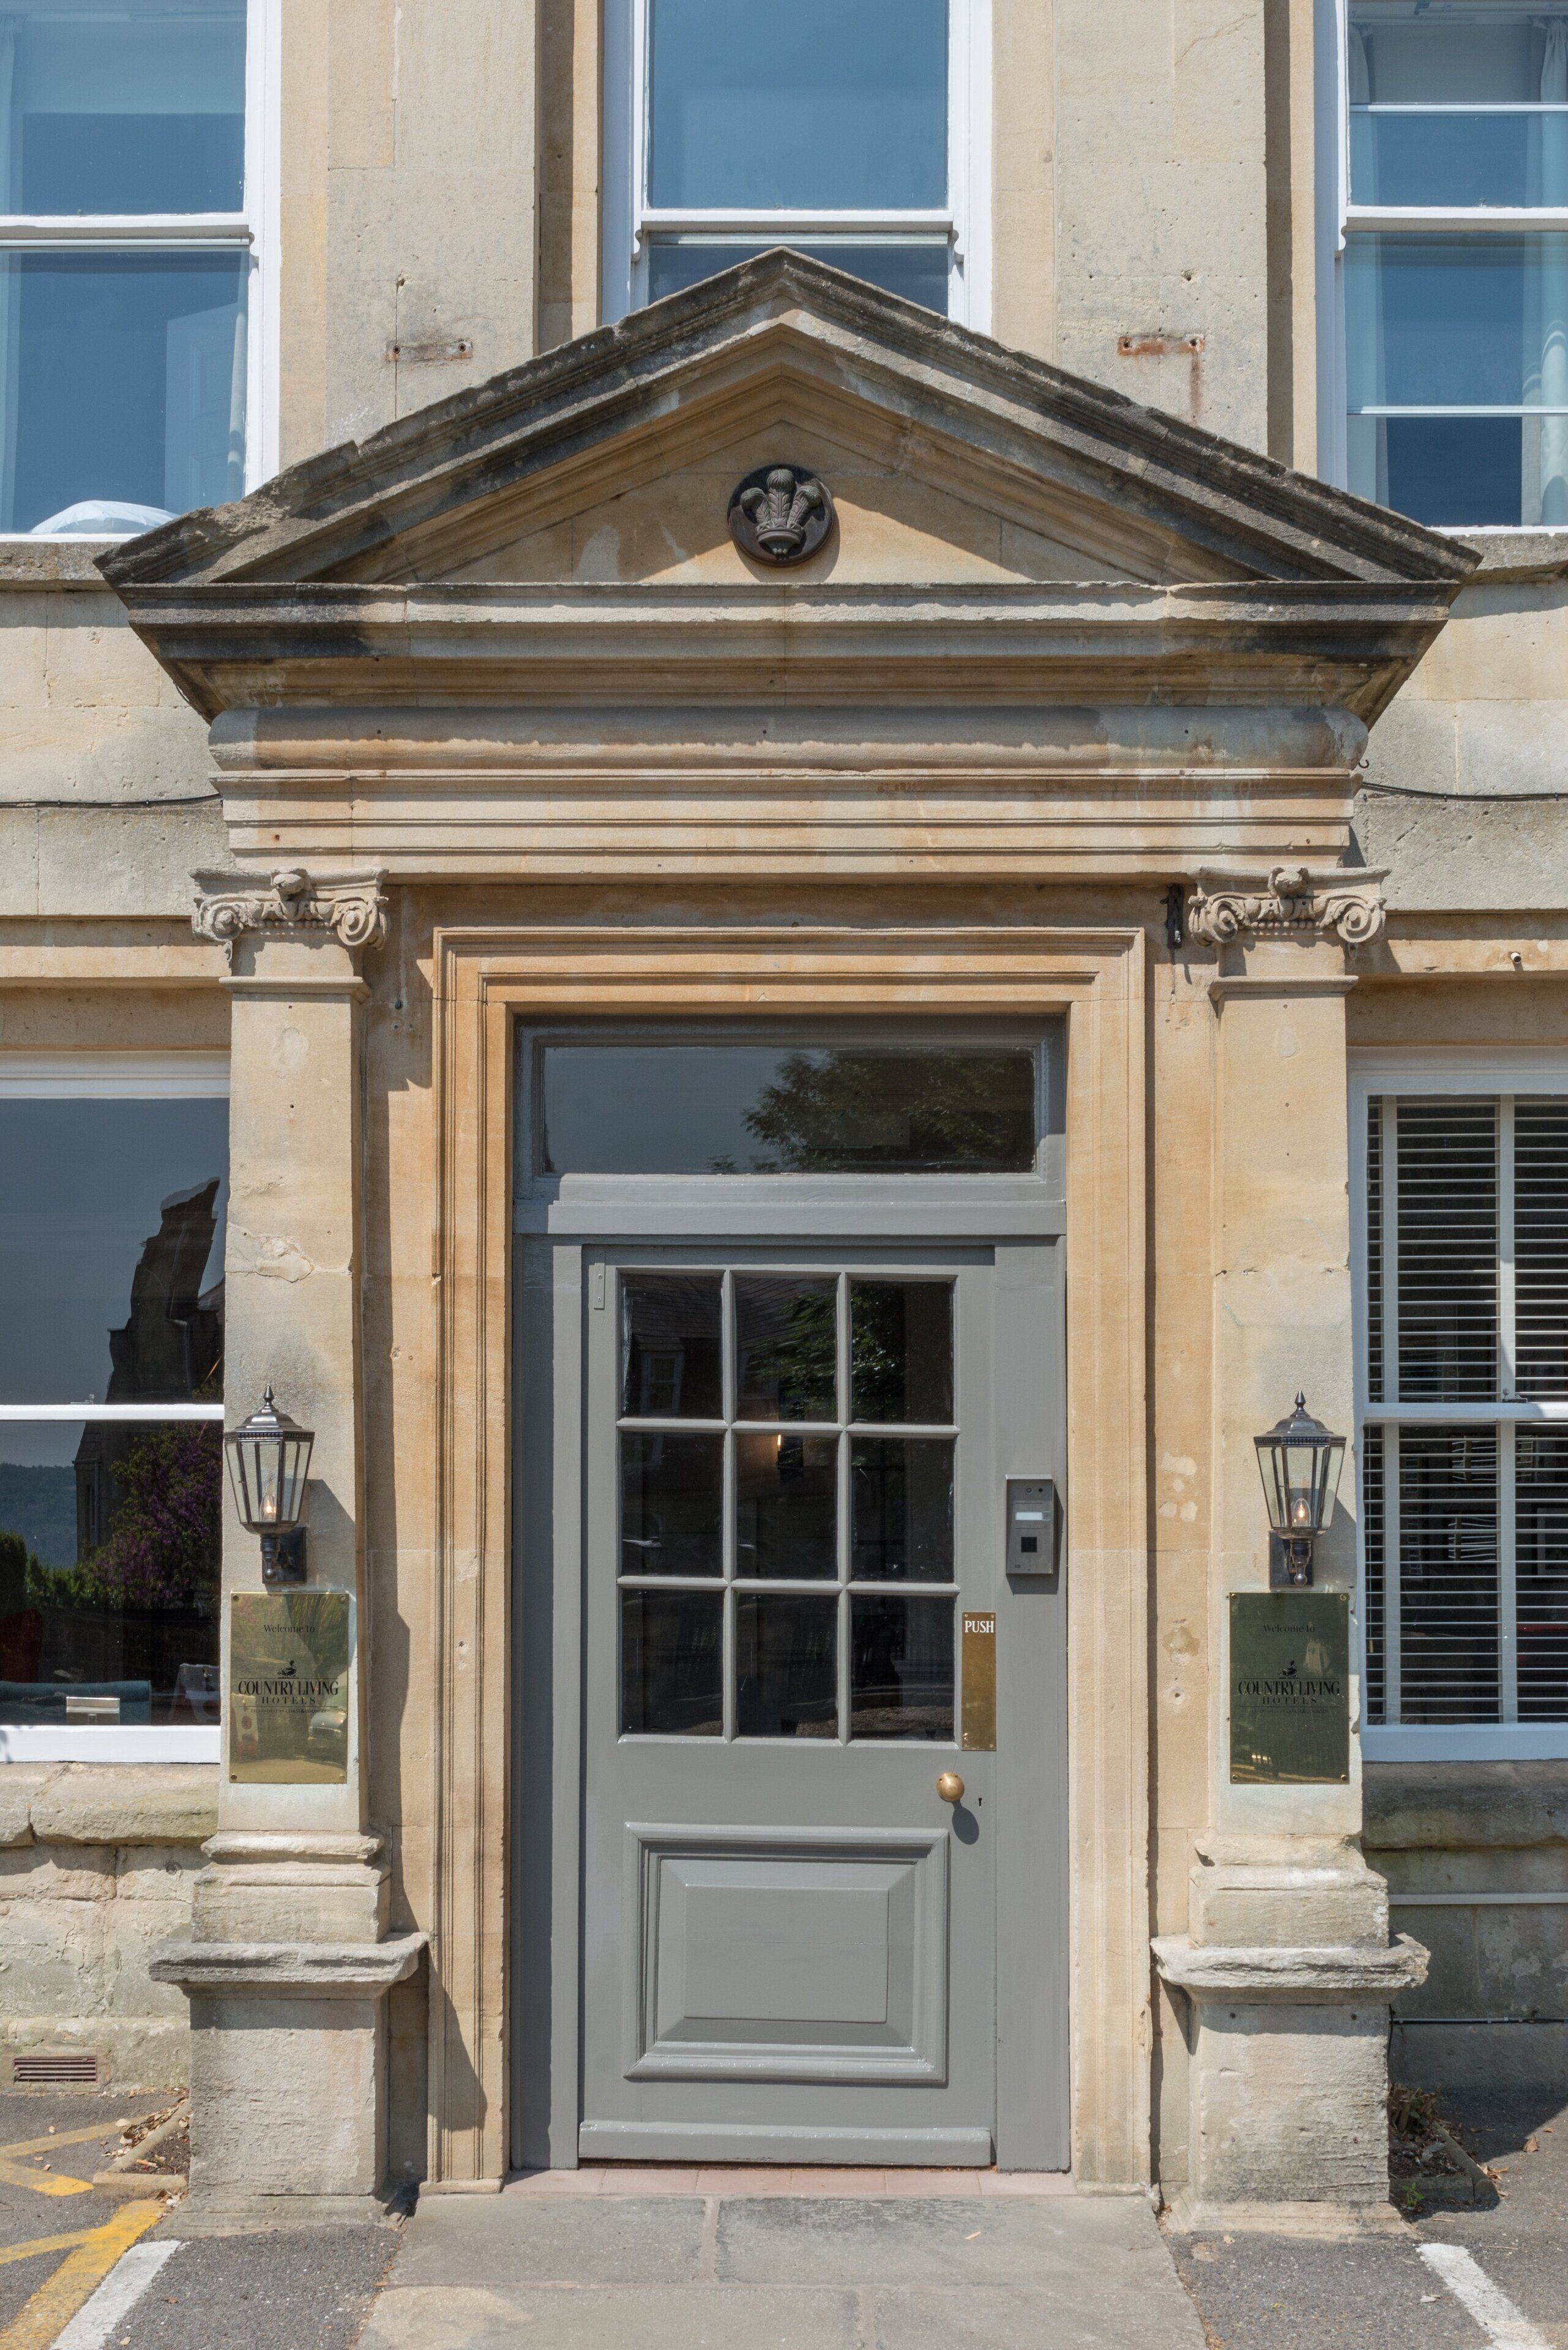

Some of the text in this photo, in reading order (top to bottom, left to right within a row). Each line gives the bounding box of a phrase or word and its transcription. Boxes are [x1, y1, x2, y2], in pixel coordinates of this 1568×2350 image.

[263, 1624, 304, 1633] Welcome
[965, 1621, 995, 1633] PUSH
[1263, 1624, 1315, 1633] Welcome to
[238, 1680, 338, 1695] COUNTRY LIVING
[1238, 1680, 1340, 1695] COUNTRY LIVING
[262, 1696, 316, 1704] HOTELS
[1263, 1696, 1317, 1705] HOTELS
